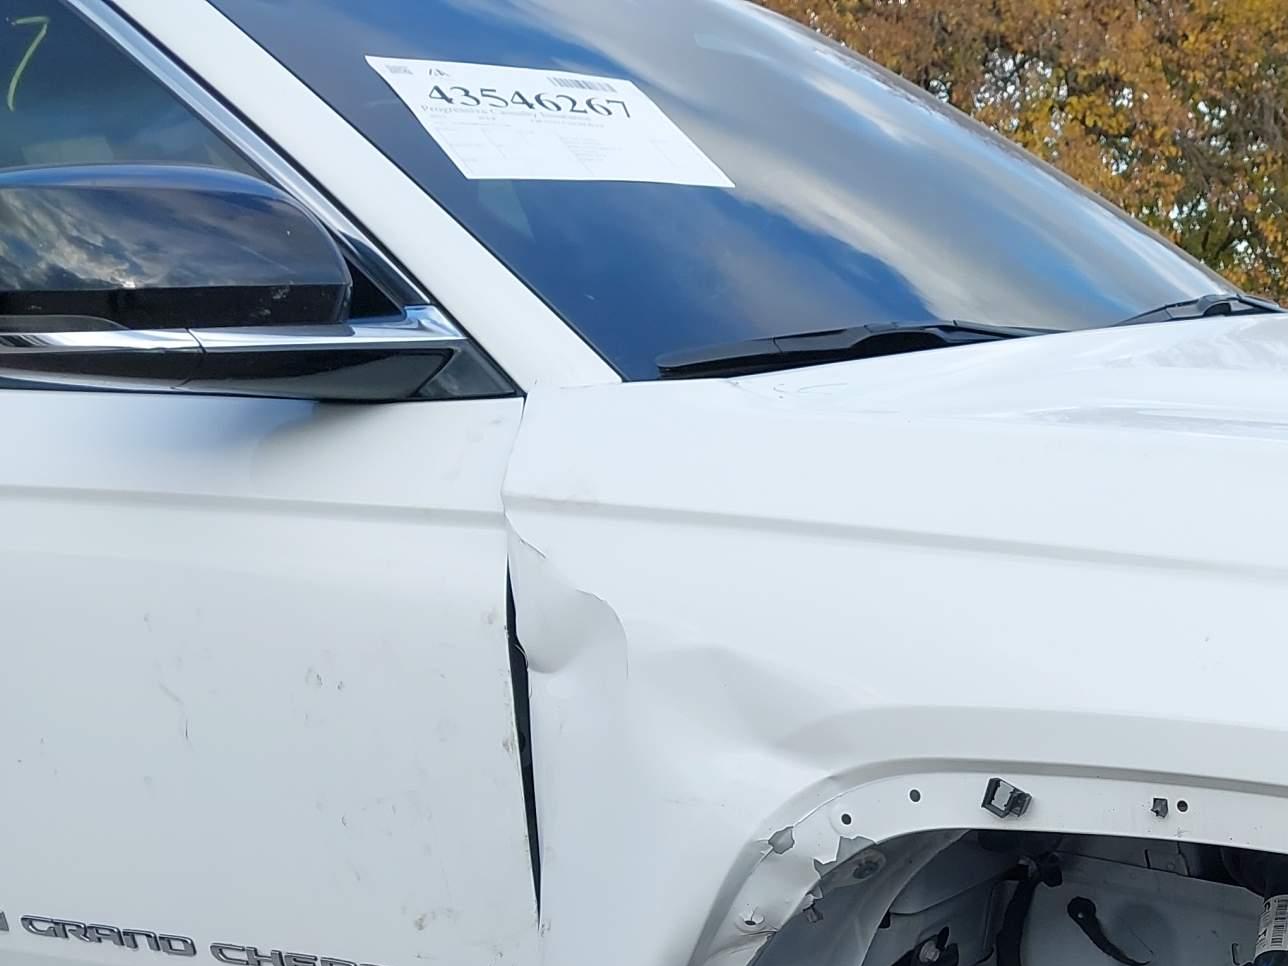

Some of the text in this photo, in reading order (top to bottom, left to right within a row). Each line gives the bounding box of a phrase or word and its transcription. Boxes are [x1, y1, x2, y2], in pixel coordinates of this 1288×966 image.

[7, 15, 51, 112] 7
[427, 83, 632, 119] 43546267
[19, 914, 198, 957] GRAND
